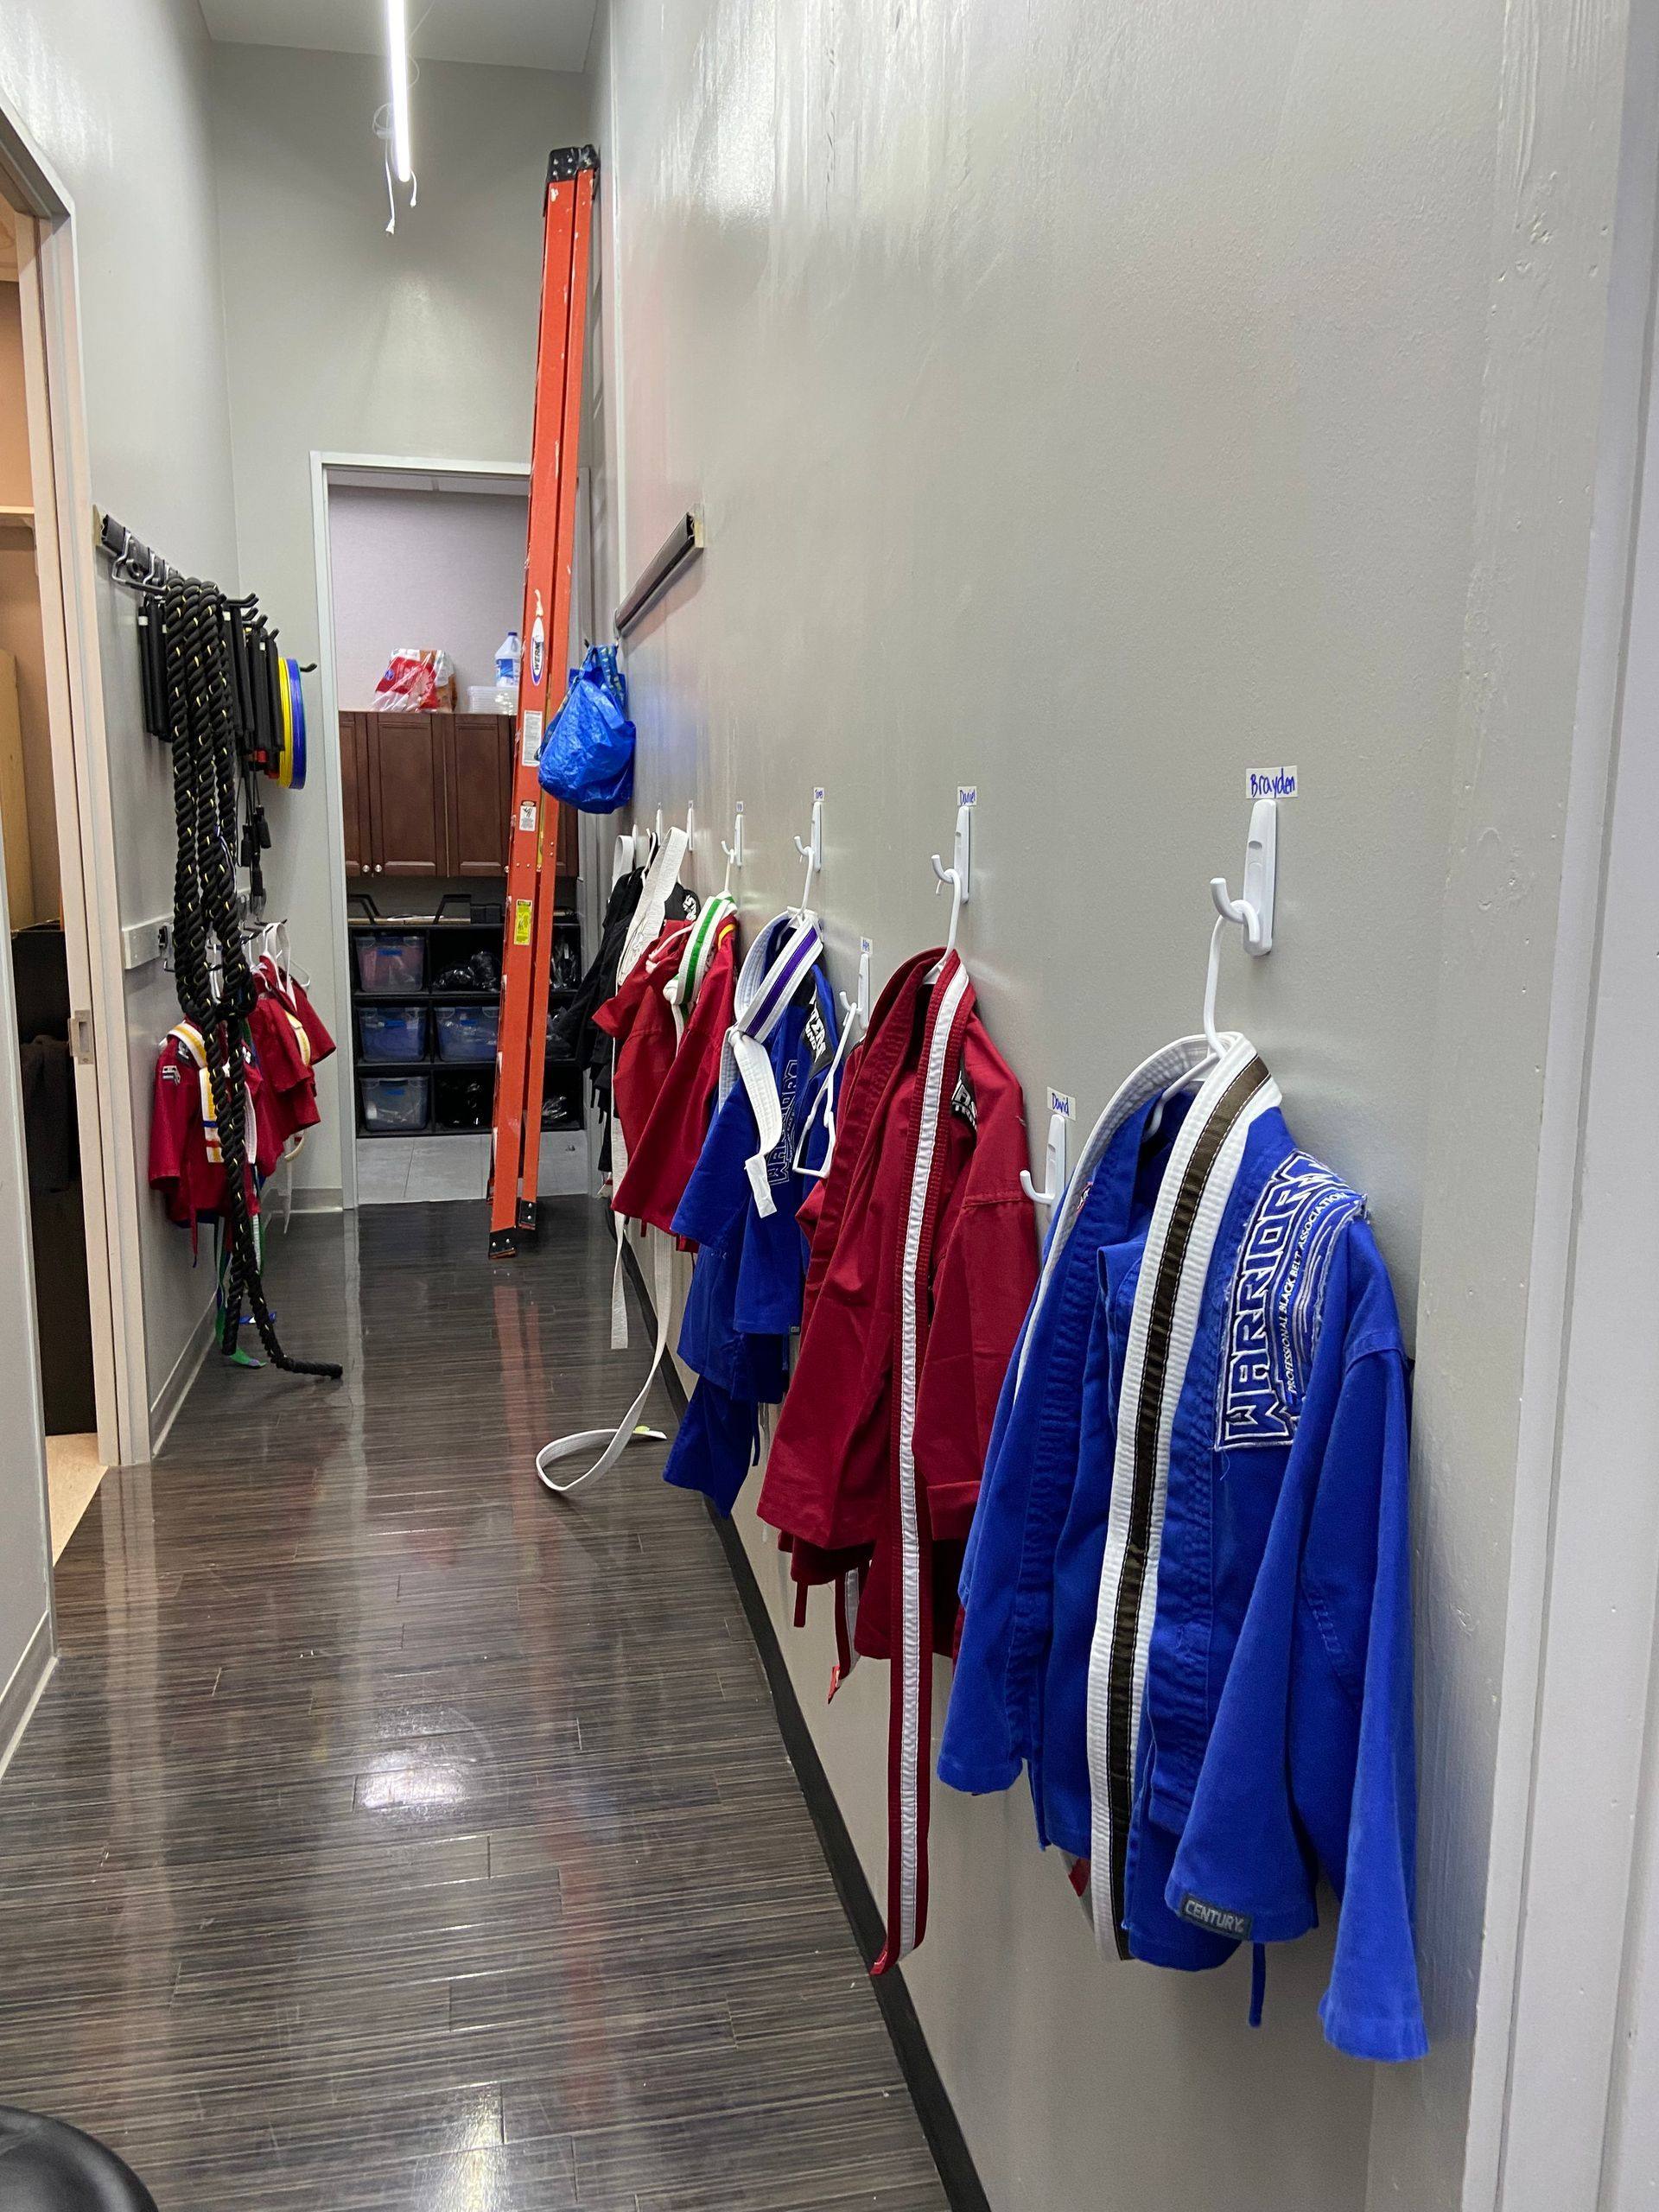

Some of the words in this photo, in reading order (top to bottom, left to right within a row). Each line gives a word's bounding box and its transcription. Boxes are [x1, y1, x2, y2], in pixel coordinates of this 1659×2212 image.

[1249, 767, 1295, 798] Brayden
[1298, 1192, 1346, 1249] ASSOCIATION
[1289, 1250, 1302, 1278] BELT
[1279, 1277, 1296, 1313] BLACK
[1279, 1316, 1297, 1395] PROFESSIONAL
[1185, 1899, 1244, 1933] CENTURY
